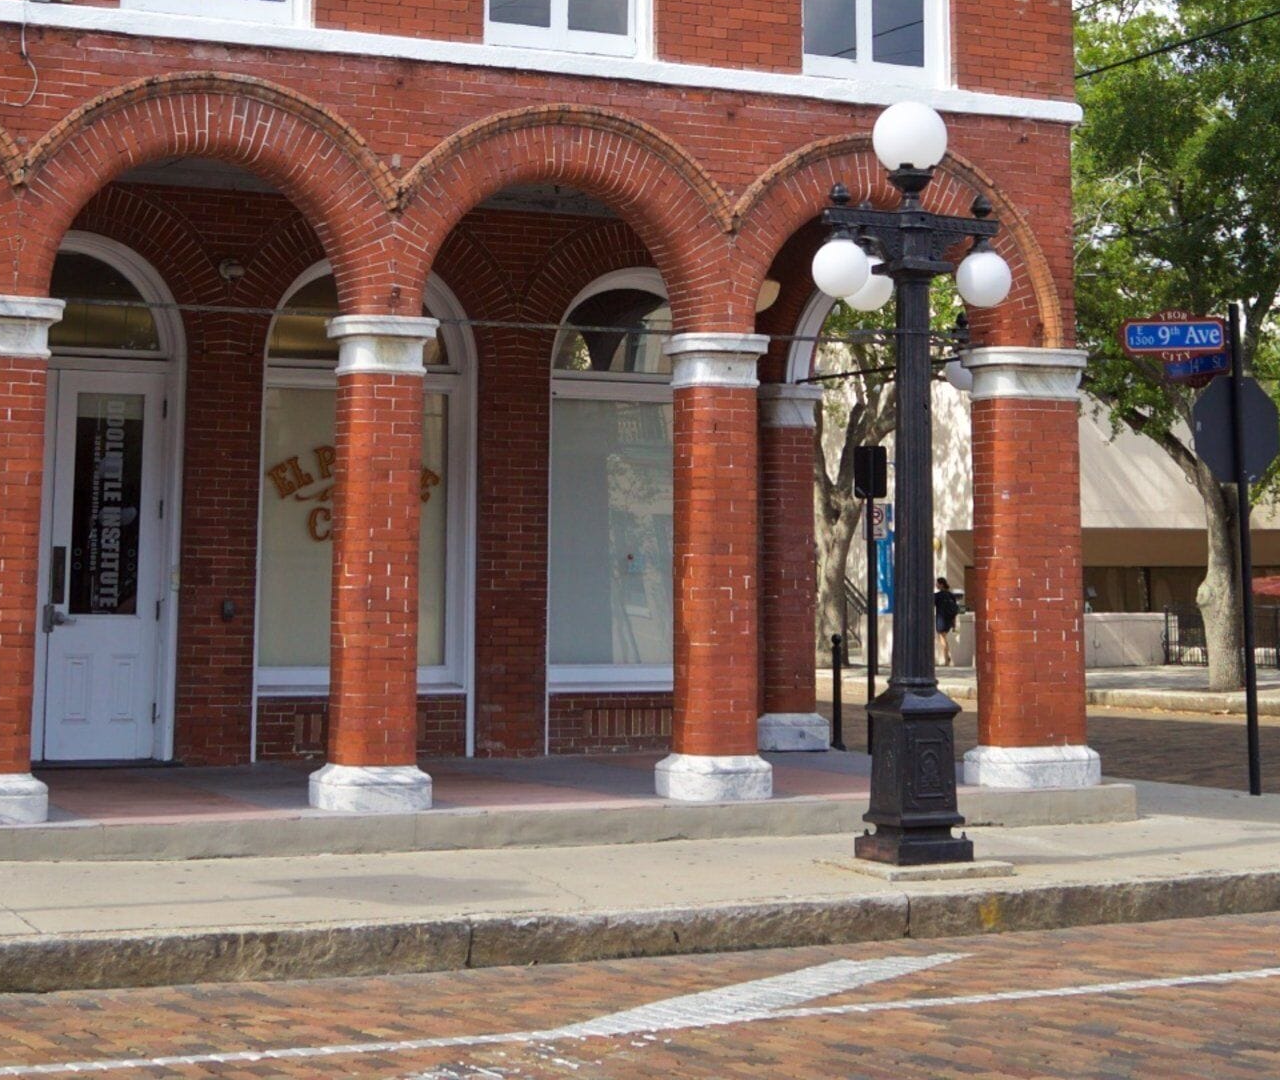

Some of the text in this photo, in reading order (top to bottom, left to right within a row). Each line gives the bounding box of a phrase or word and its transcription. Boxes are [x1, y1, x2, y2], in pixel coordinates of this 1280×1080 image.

[1160, 311, 1187, 321] YBOR
[1130, 336, 1155, 345] 1300
[1158, 326, 1220, 345] 9th Ave
[1162, 351, 1191, 362] CITY
[267, 456, 314, 498] EL
[99, 506, 121, 608] INSTITUTE
